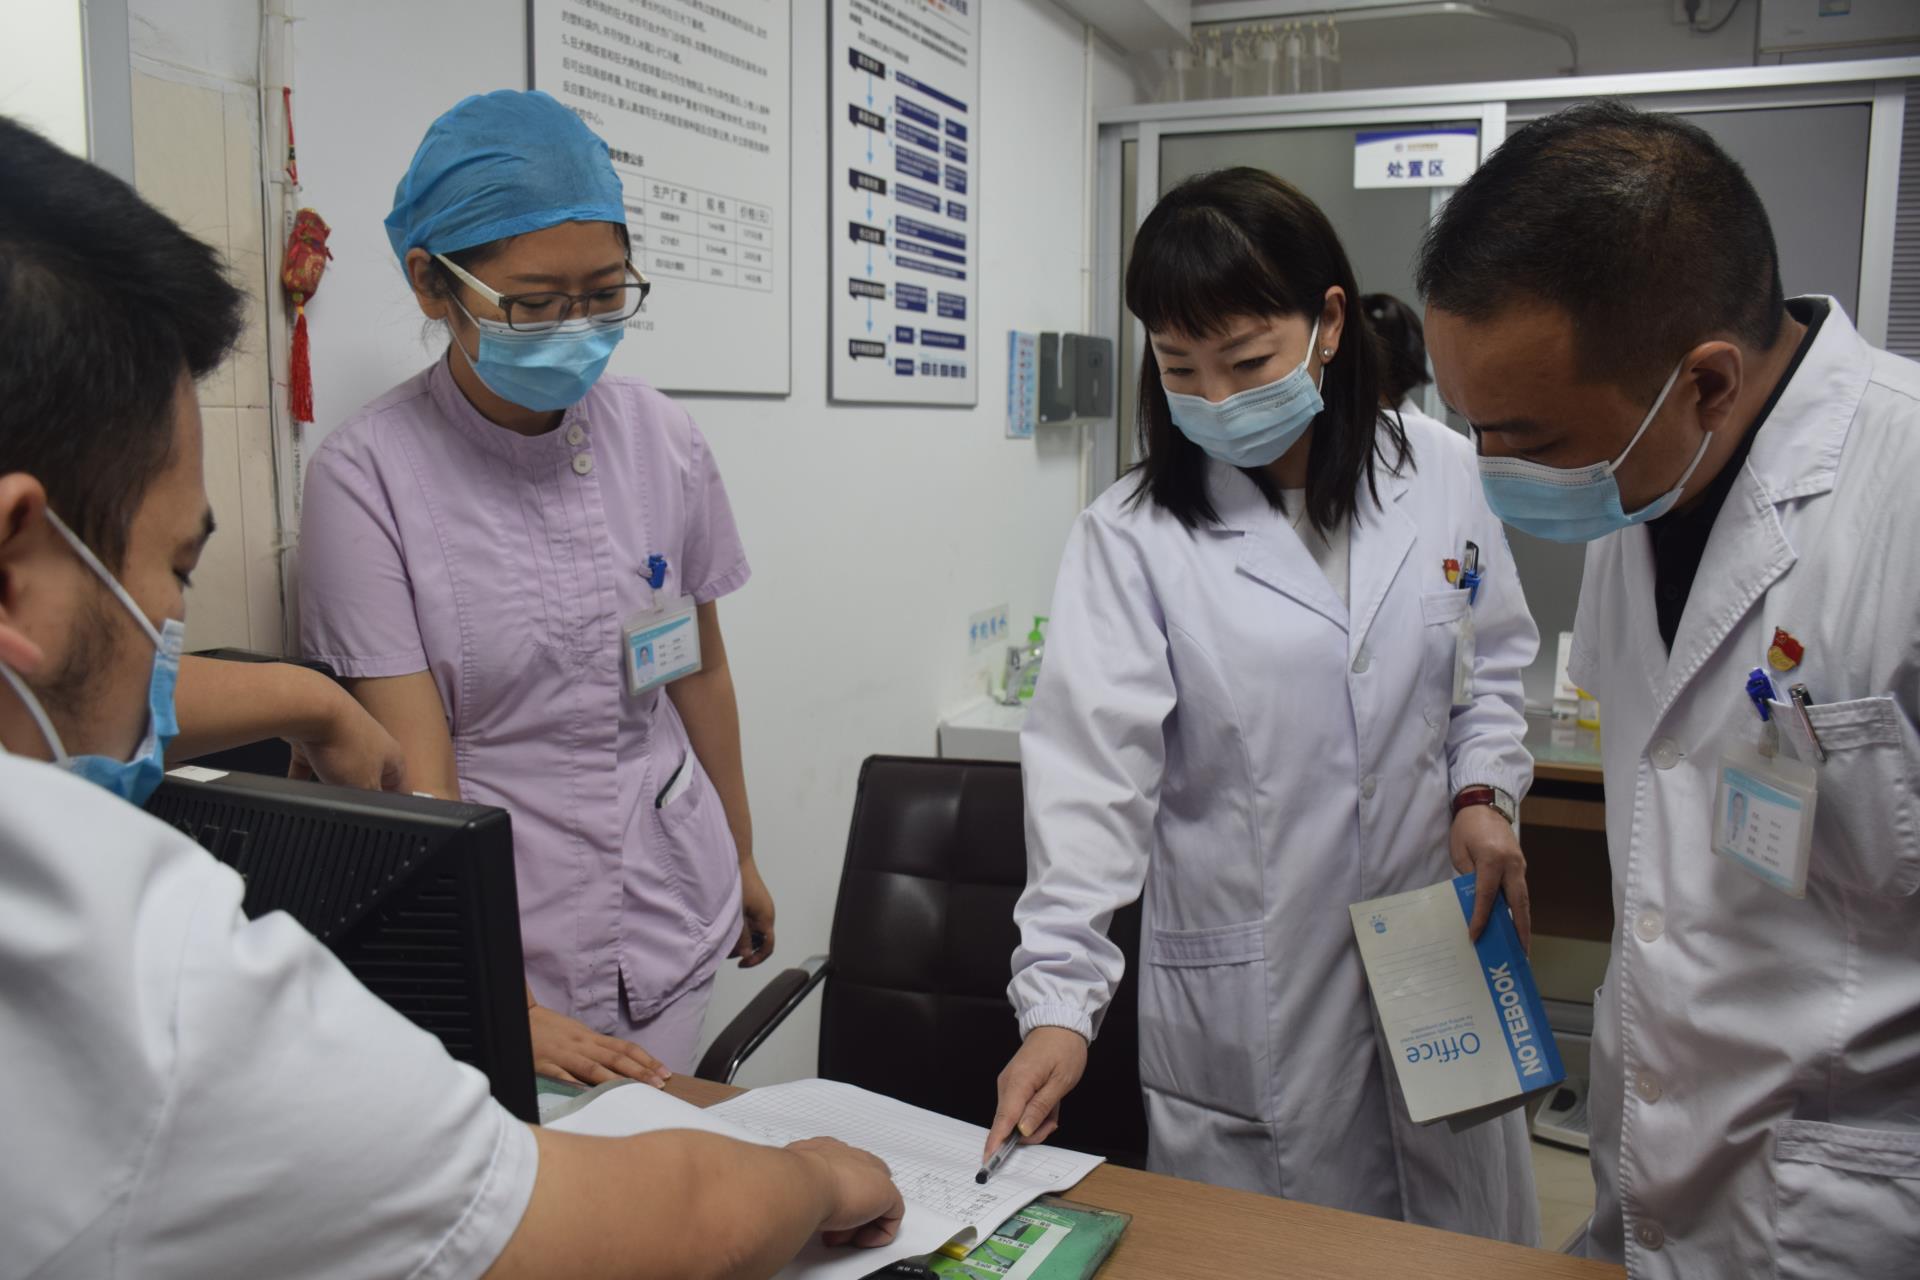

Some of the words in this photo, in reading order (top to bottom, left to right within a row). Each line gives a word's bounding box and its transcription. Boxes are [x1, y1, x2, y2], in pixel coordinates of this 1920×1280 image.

[1387, 160, 1444, 178] 处置区
[653, 184, 688, 204] 生产厂家
[1488, 961, 1542, 1077] NOTEBOOK
[1406, 1032, 1480, 1063] Office
